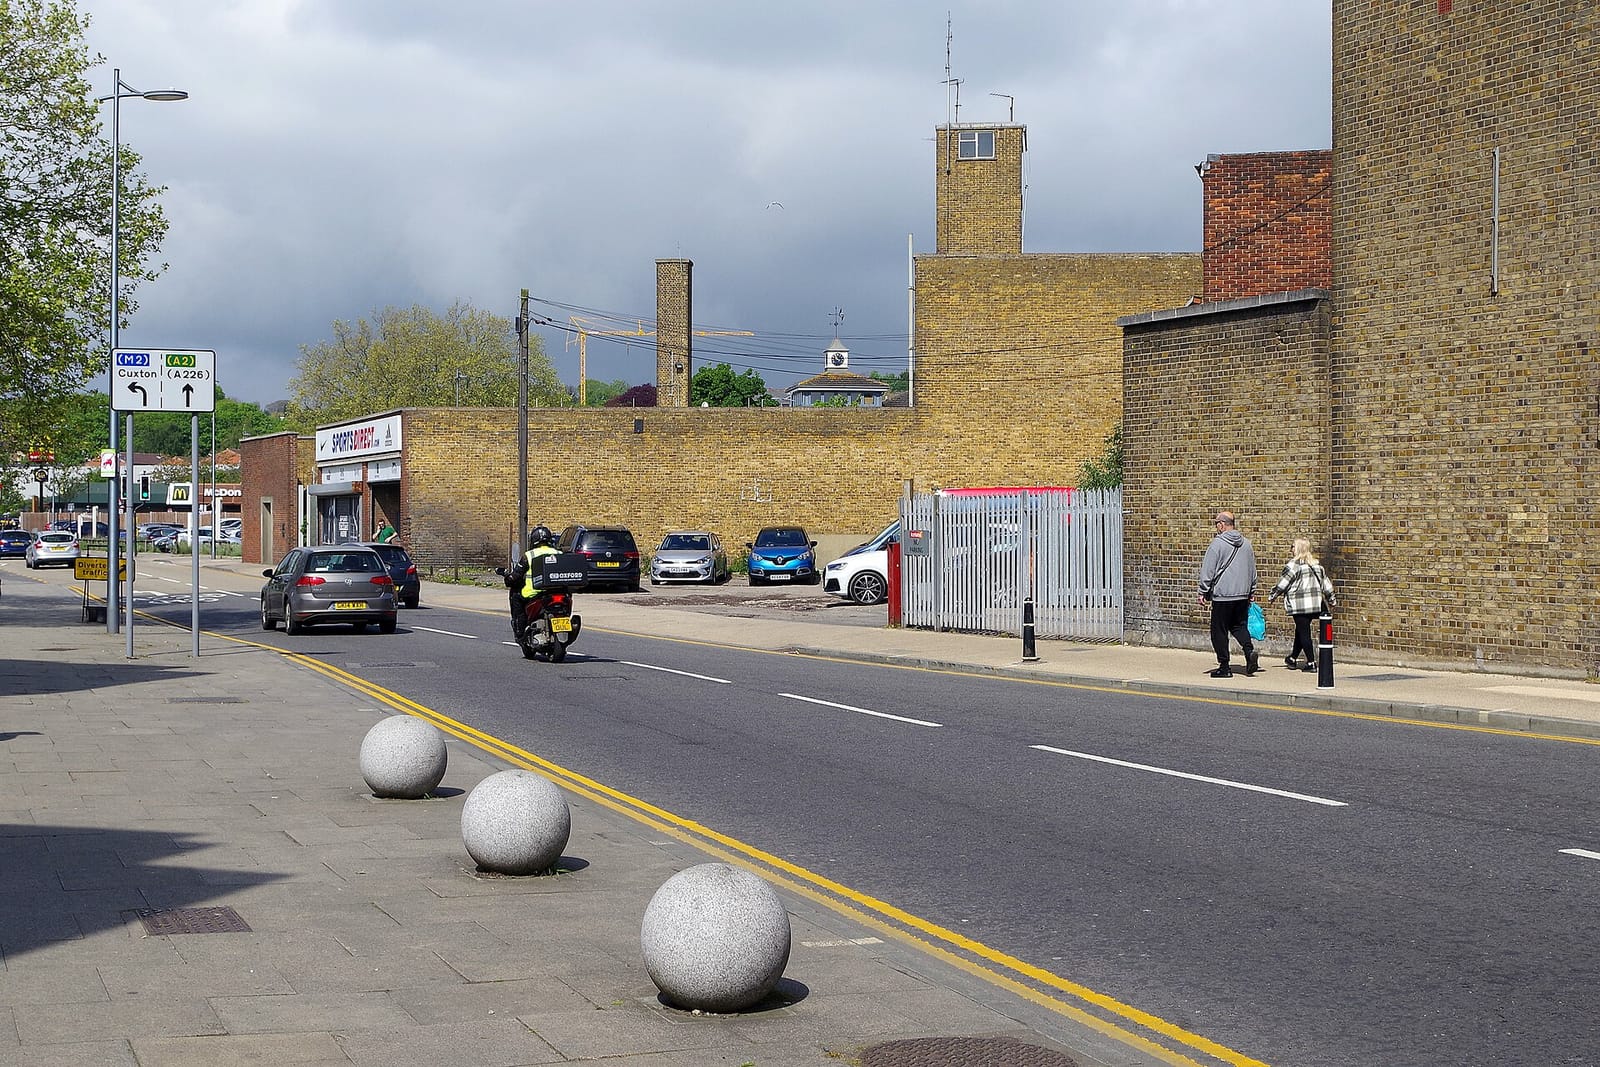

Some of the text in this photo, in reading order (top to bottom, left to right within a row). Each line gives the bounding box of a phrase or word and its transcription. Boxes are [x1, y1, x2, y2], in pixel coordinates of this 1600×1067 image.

[117, 354, 149, 365] (M2)
[167, 355, 195, 366] (A2)
[118, 368, 157, 378] Cuxton
[167, 370, 210, 380] (A226)
[204, 488, 242, 497] McDon
